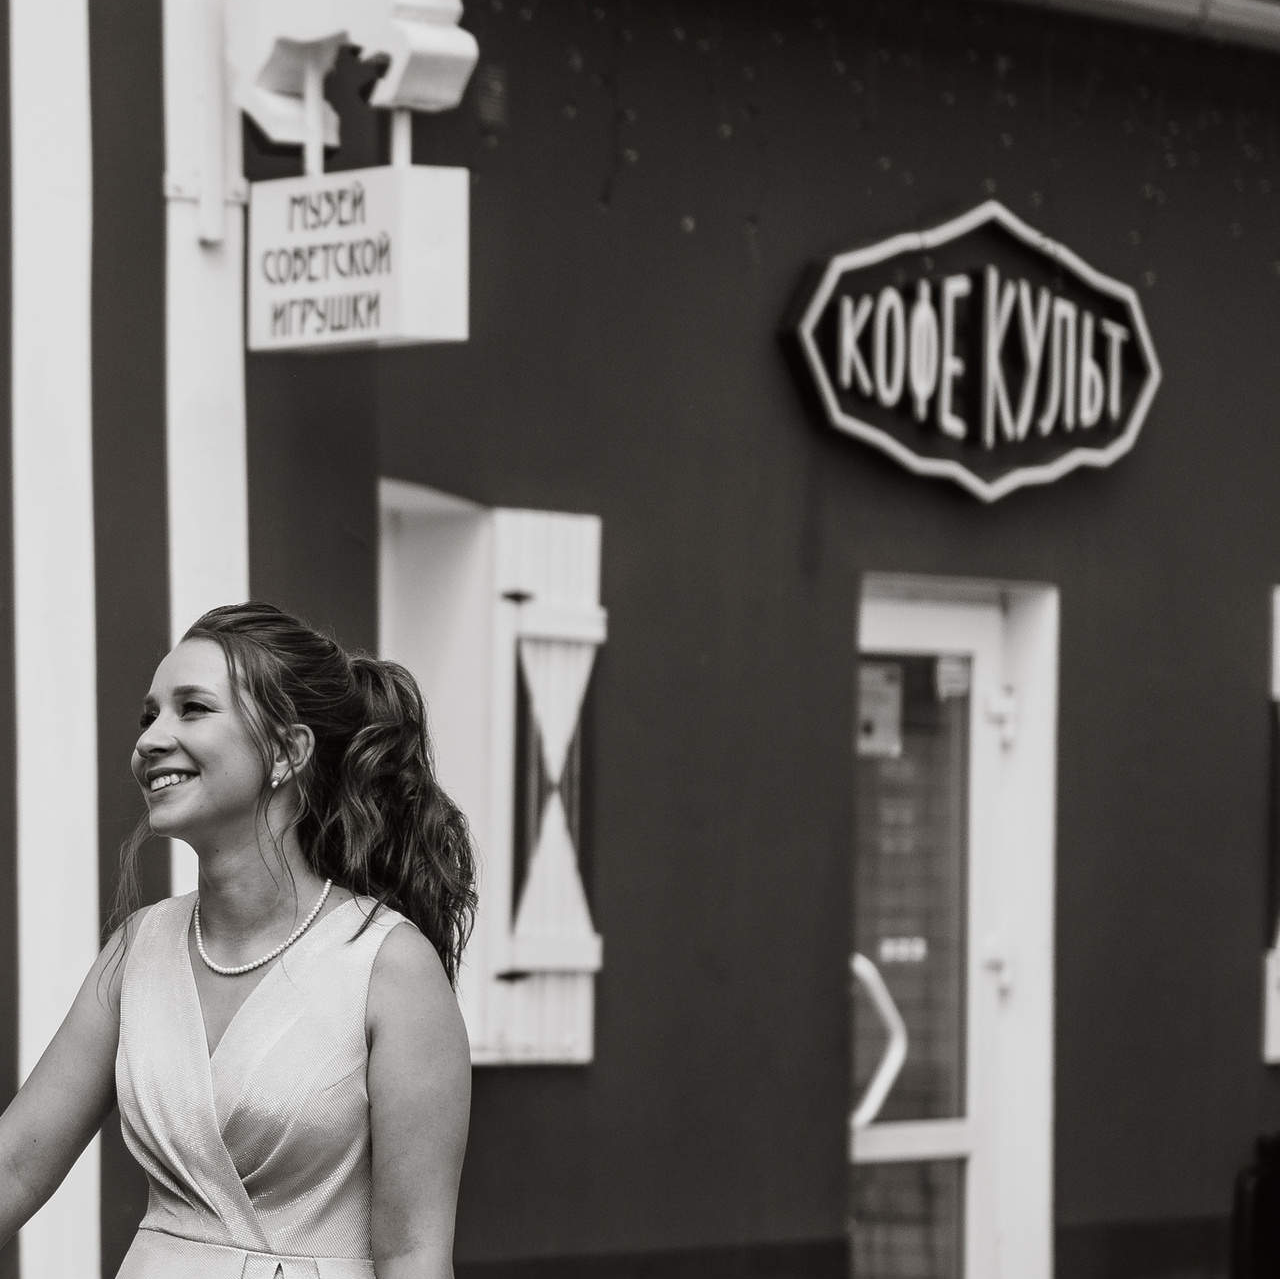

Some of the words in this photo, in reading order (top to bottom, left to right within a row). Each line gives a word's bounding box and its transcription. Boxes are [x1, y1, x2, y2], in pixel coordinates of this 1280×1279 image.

[287, 180, 366, 233] МУЗЕЙ
[261, 230, 392, 285] СОВЕТСКОЙ
[270, 290, 381, 338] ИГРУШКИ
[839, 273, 971, 441] КОФЕ
[983, 264, 1129, 451] КУЛЬТ
